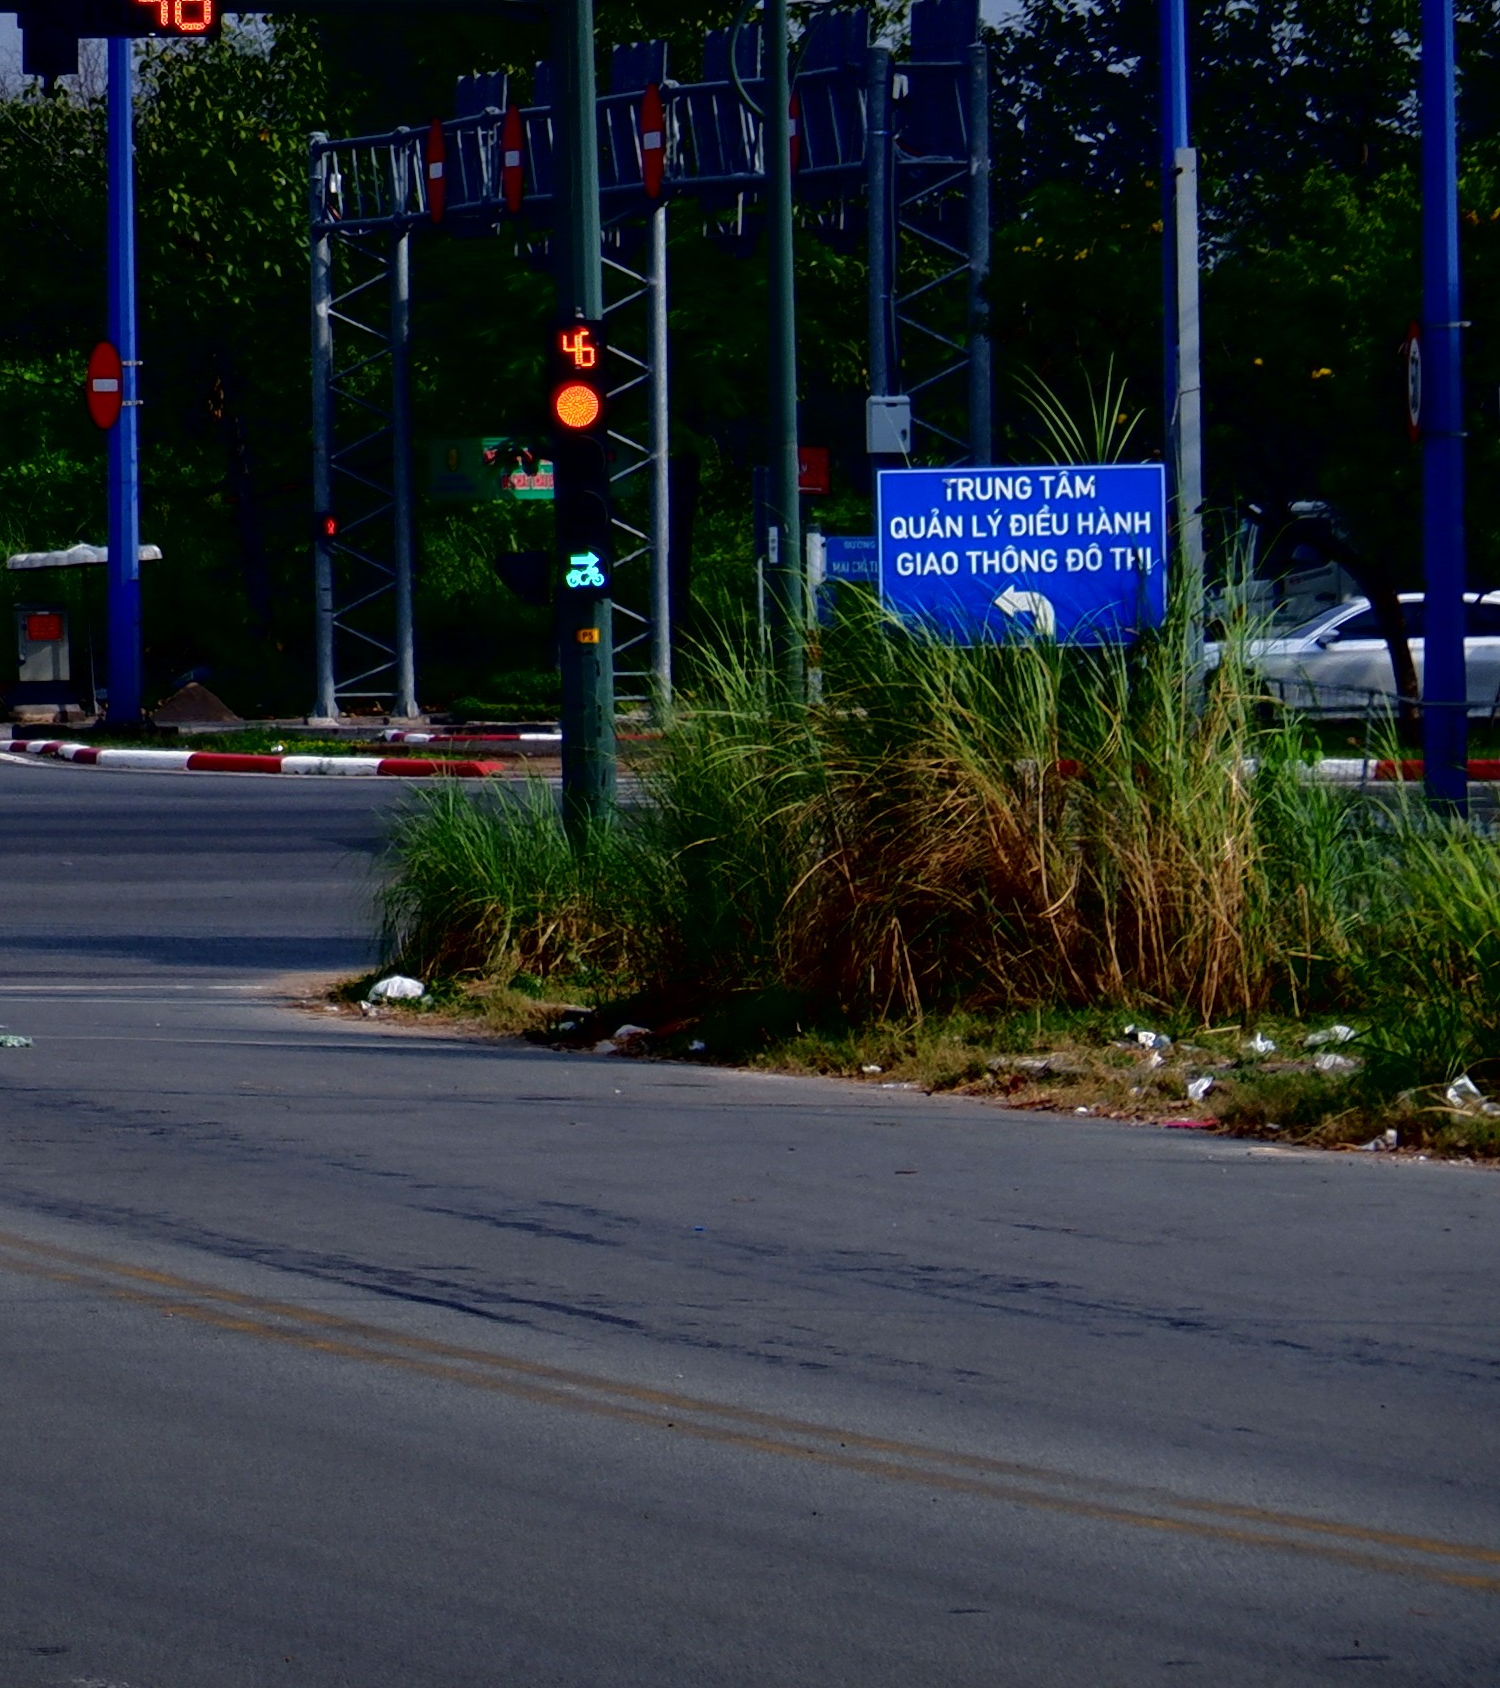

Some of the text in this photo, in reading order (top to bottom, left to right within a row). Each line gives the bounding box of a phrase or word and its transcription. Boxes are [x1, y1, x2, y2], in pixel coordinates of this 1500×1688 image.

[561, 330, 596, 368] 46
[942, 470, 1097, 503] TRUNG TÂM
[889, 504, 1152, 540] QUẢN LÝ ĐIỀU HÀNH
[895, 542, 1153, 577] GIAO THÔNG ĐÔ THỊ
